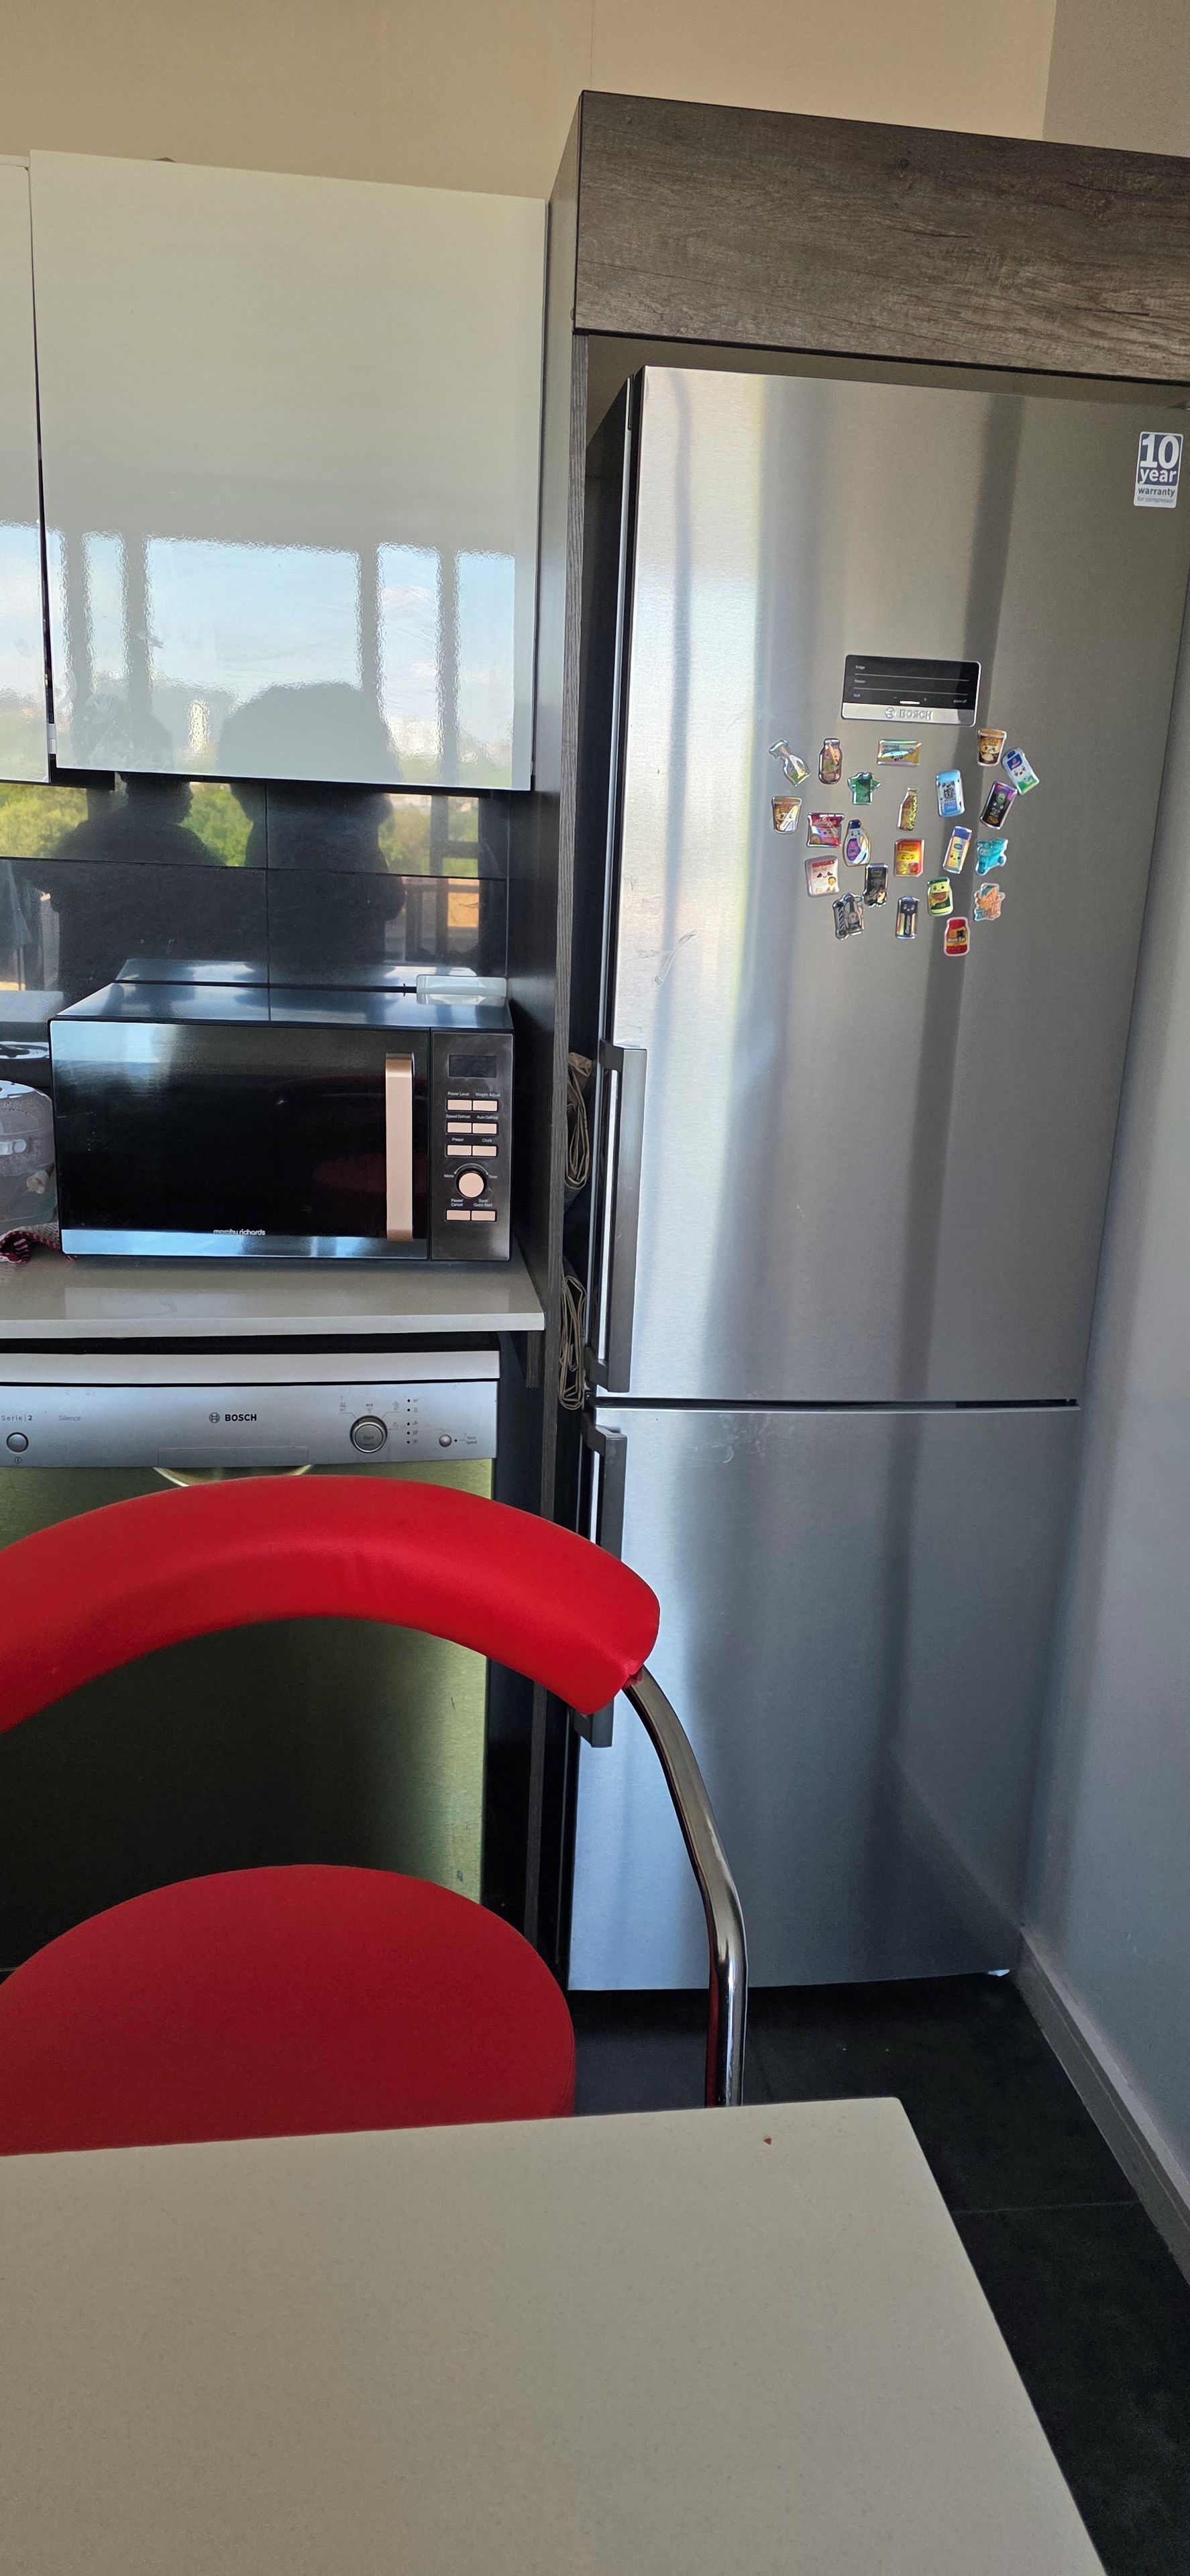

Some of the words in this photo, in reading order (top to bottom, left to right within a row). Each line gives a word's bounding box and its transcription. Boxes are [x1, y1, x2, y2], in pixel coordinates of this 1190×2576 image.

[1140, 434, 1179, 470] 10
[1139, 468, 1177, 484] year
[1138, 487, 1175, 498] warranty
[900, 709, 934, 720] BOSCH
[225, 1413, 257, 1421] BOSCH
